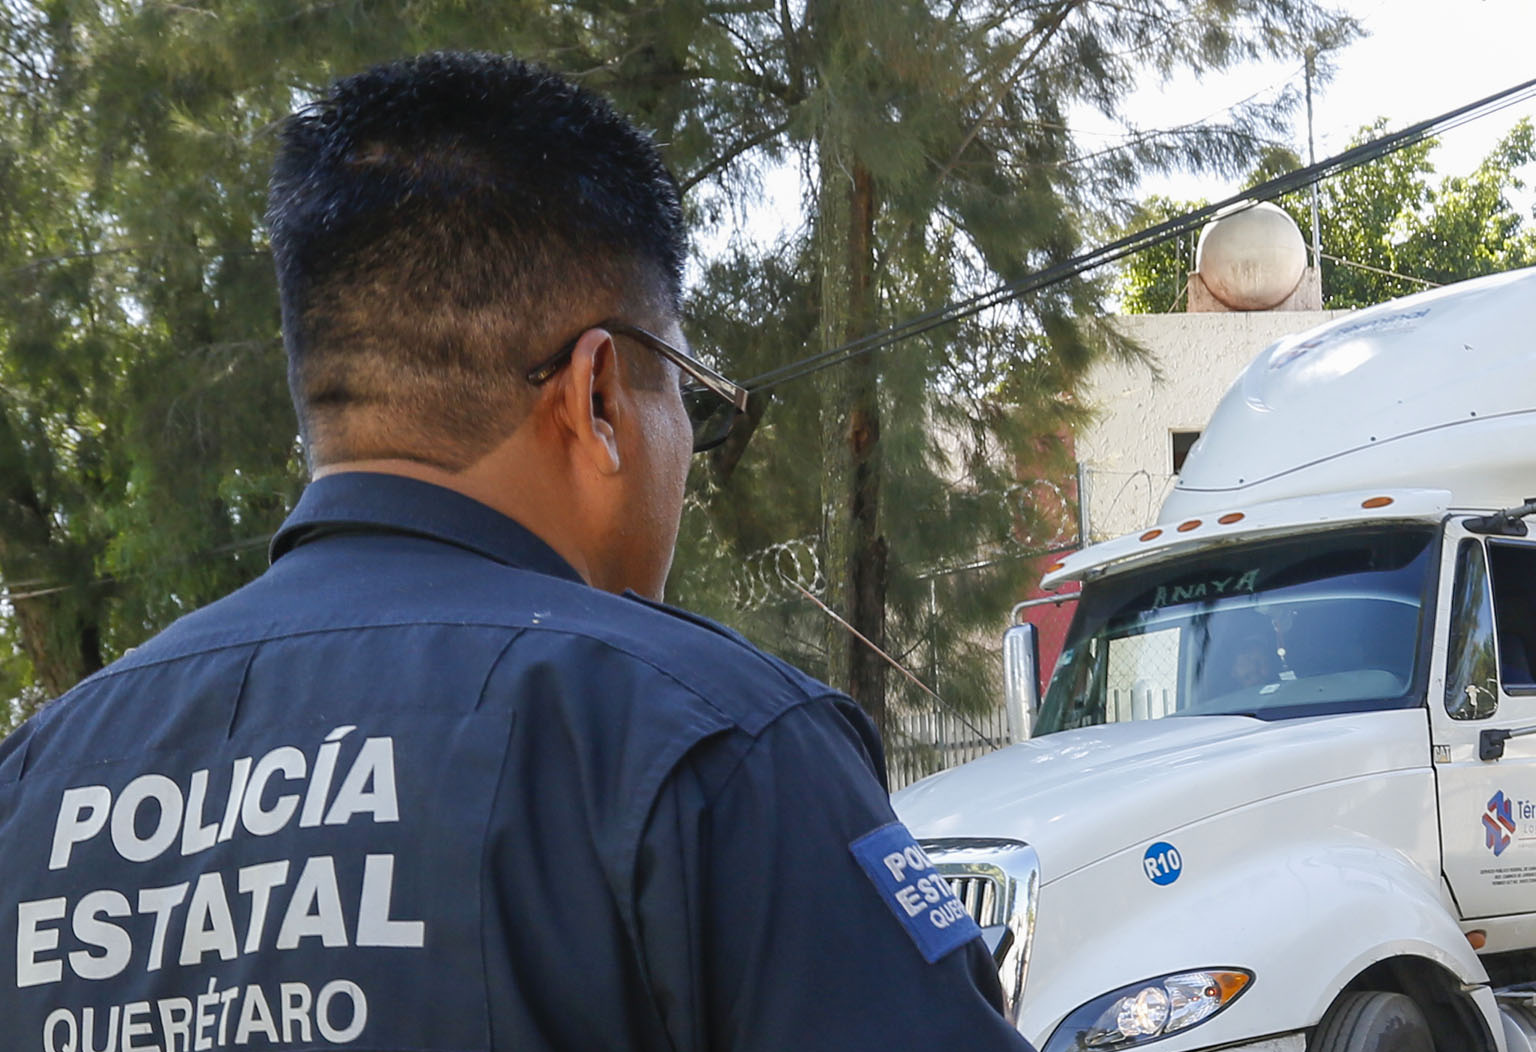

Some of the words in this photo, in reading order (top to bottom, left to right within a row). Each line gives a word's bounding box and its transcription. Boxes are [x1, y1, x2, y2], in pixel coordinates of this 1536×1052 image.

[1152, 568, 1260, 609] ANAYA
[48, 725, 400, 870] POLICÍA
[1144, 849, 1180, 879] R10
[16, 854, 425, 988] ESTATAL
